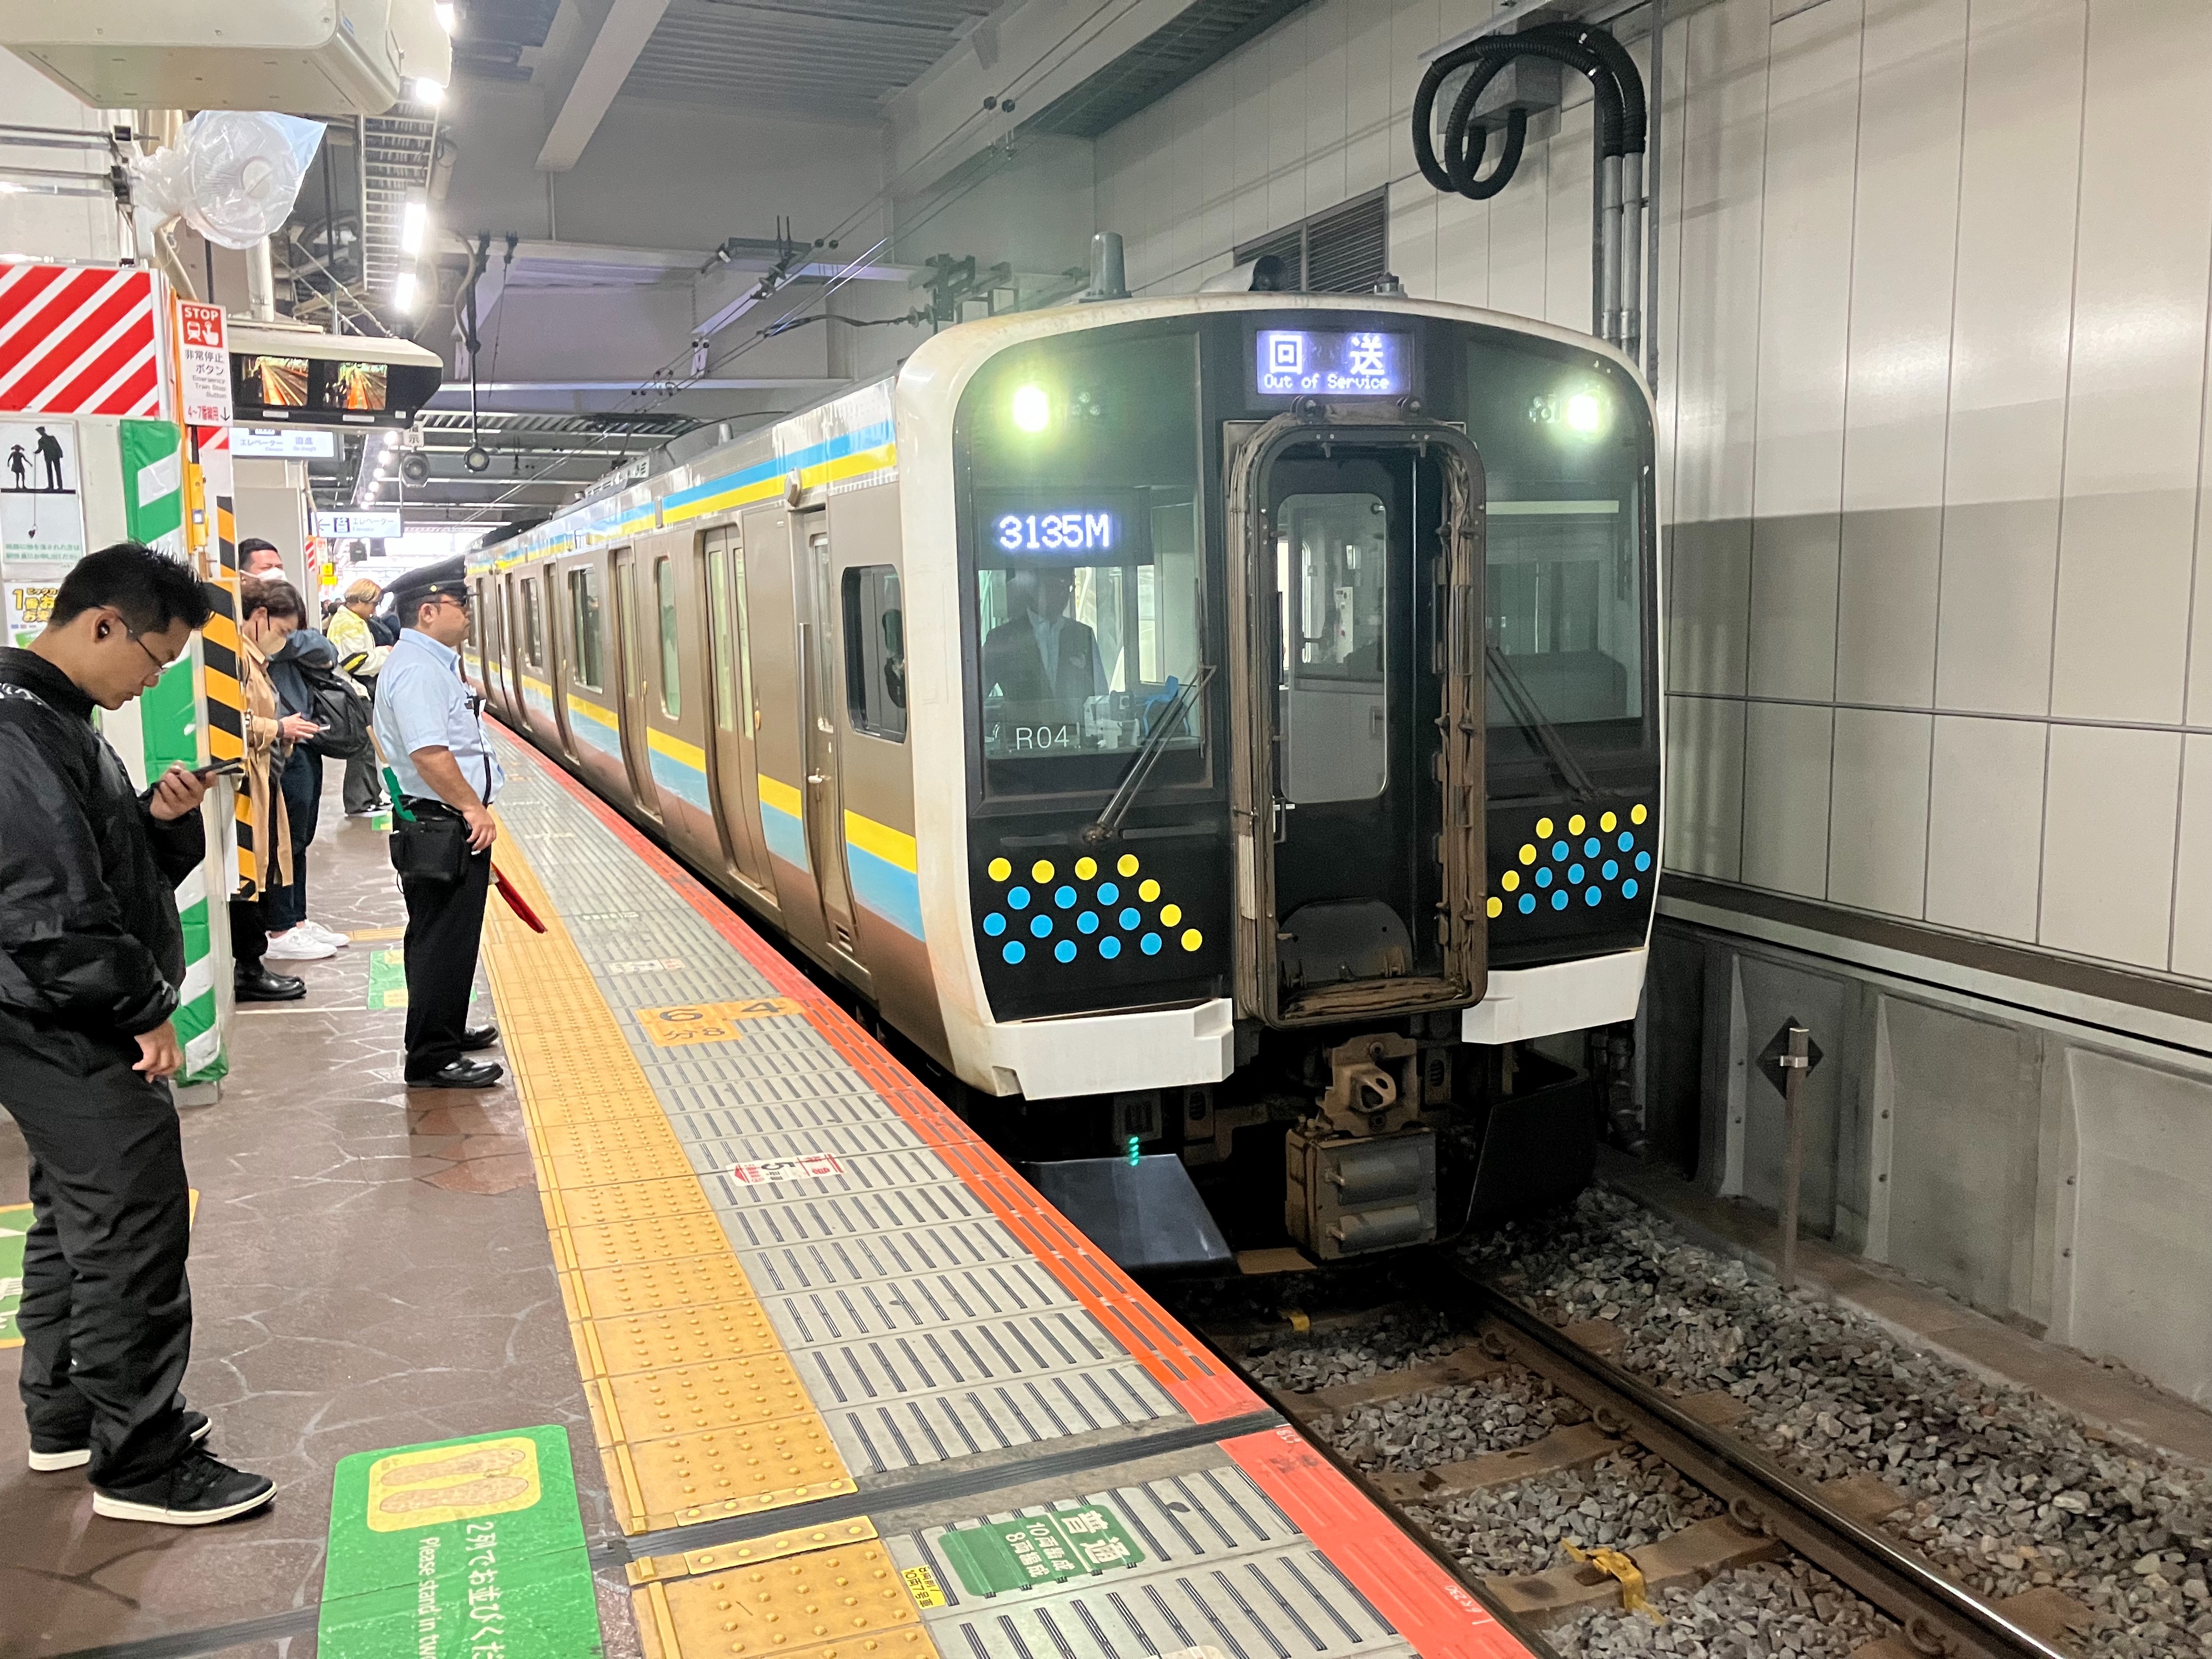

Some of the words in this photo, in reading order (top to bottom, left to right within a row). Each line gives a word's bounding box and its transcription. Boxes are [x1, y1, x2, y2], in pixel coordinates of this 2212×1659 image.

[184, 307, 219, 321] STOP
[185, 349, 224, 363] 非常停止
[196, 364, 224, 375] ボタン
[1269, 335, 1385, 375] 回送
[1264, 374, 1293, 389] Out
[1301, 373, 1320, 389] of
[1327, 373, 1390, 390] Service
[999, 514, 1109, 549] 3135M
[1015, 725, 1070, 750] R04
[1005, 1531, 1050, 1578] 8両編成
[1026, 1522, 1075, 1571] 10両編成
[1061, 1510, 1131, 1564] 普通
[418, 1537, 441, 1576] Please
[417, 1579, 442, 1616] stand
[418, 1616, 442, 1632] in
